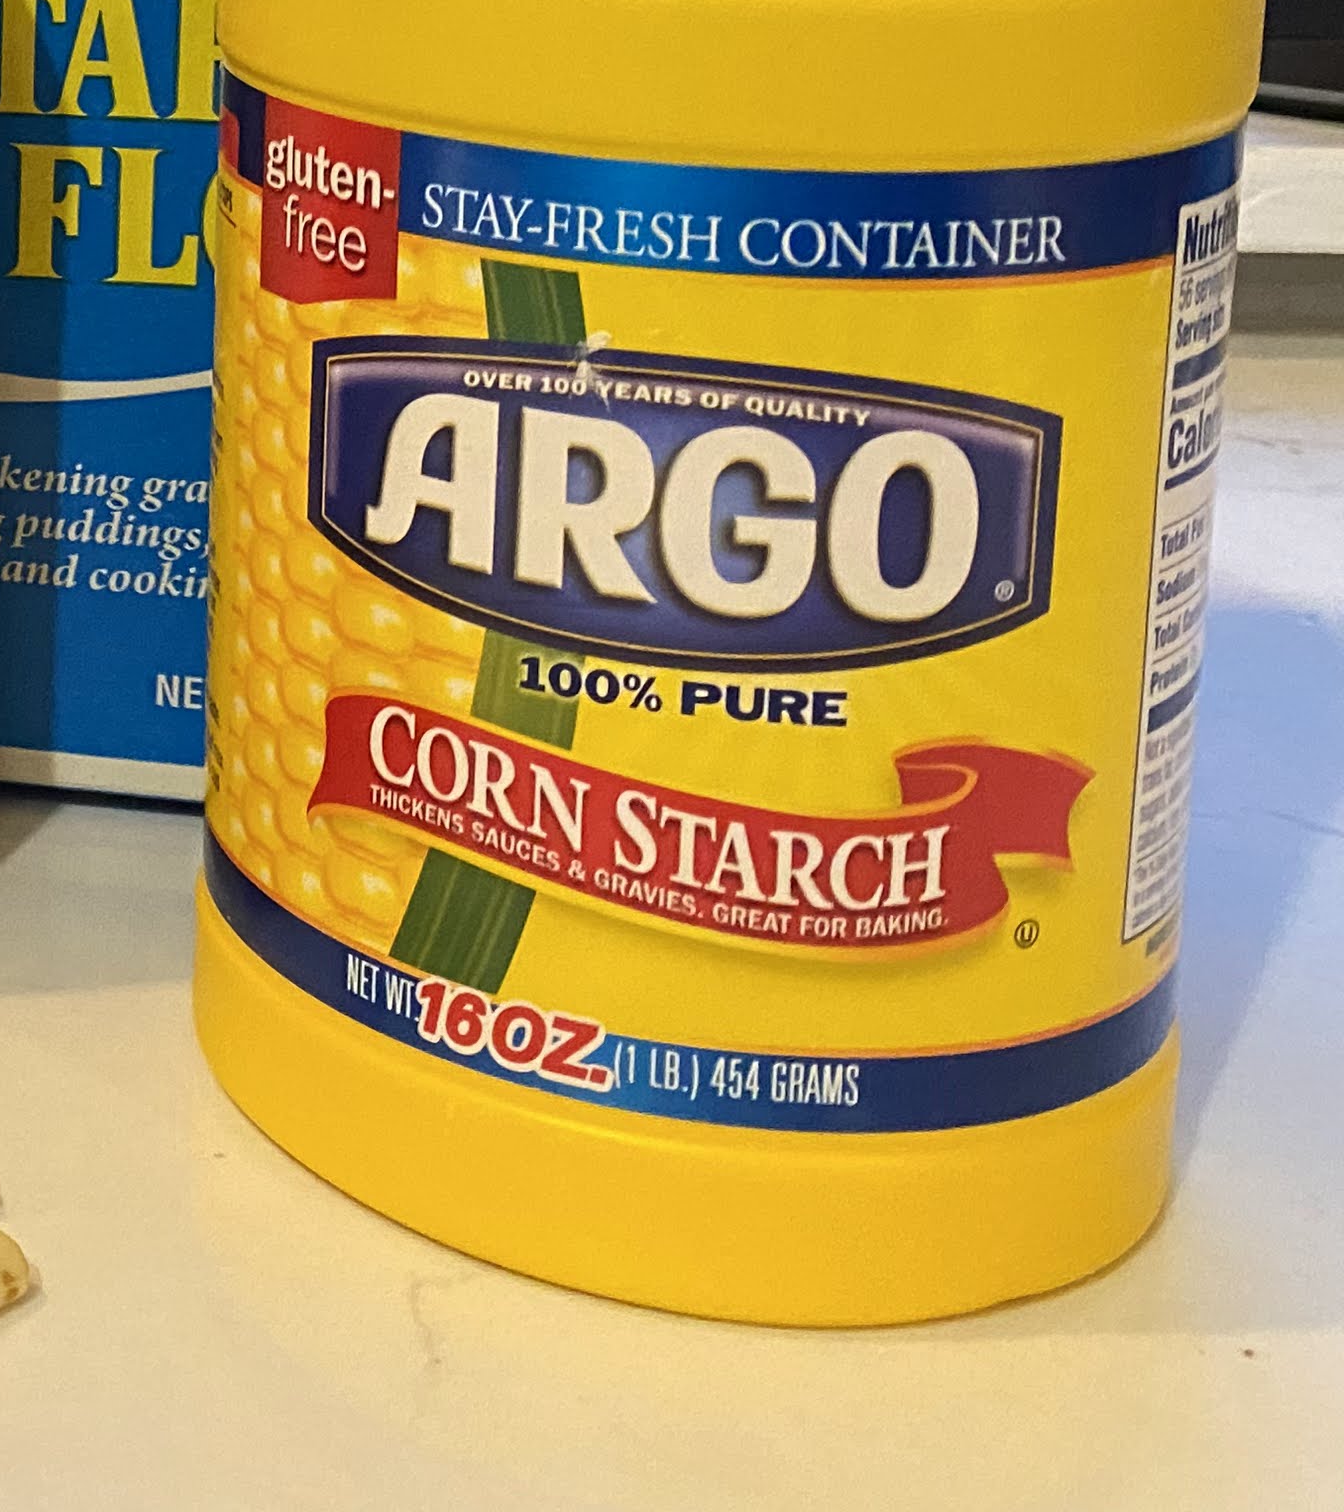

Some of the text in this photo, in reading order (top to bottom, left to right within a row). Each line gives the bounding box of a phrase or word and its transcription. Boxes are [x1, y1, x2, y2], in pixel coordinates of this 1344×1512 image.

[6, 143, 218, 286] FL
[266, 135, 396, 210] gluten-
[282, 193, 367, 274] free
[422, 182, 1066, 270] STAY-FRESH CONTAINER
[463, 370, 870, 427] OVER 100 YEARS OF QUALITY
[364, 393, 979, 625] ARGO
[0, 554, 79, 588] and
[520, 657, 848, 728] 100% PURE
[369, 706, 951, 911] CORN STARCH
[370, 784, 949, 939] THICKENS SAUCES & GRAVIES. GREAT FOR BAKING.
[347, 953, 380, 1004] NET
[614, 1042, 635, 1088] (1
[650, 1049, 699, 1101] LB.)
[710, 1057, 760, 1100] 454
[770, 1062, 861, 1106] GRAMS
